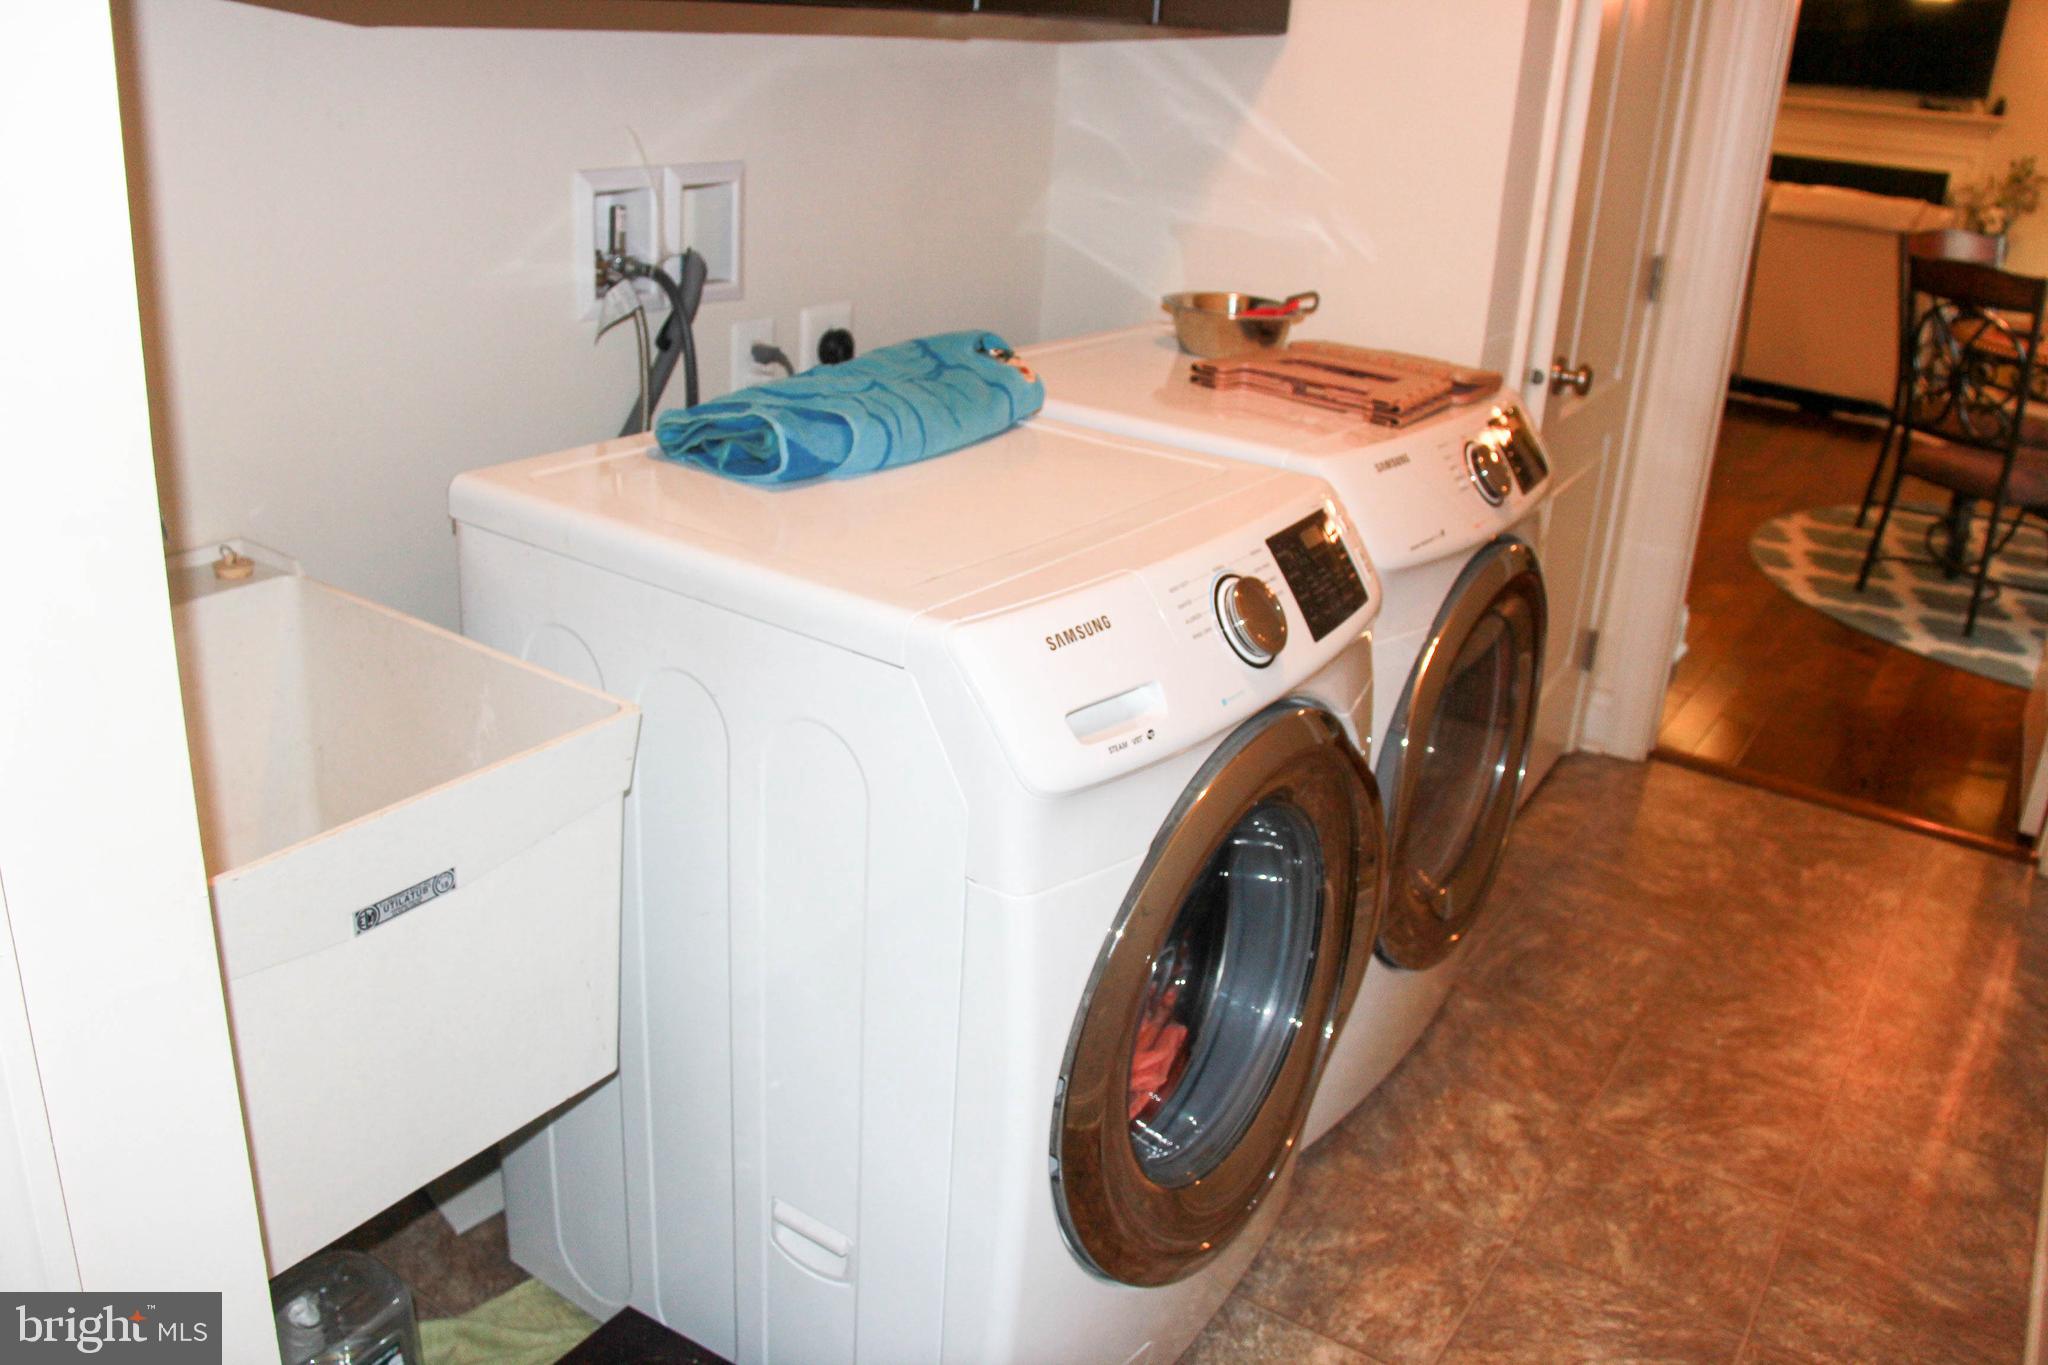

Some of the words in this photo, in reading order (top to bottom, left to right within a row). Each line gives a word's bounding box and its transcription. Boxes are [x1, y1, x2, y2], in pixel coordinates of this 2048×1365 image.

[1374, 452, 1410, 473] SAMSUNG
[1045, 615, 1111, 651] SAMSUNG
[383, 885, 430, 913] UTILATUB
